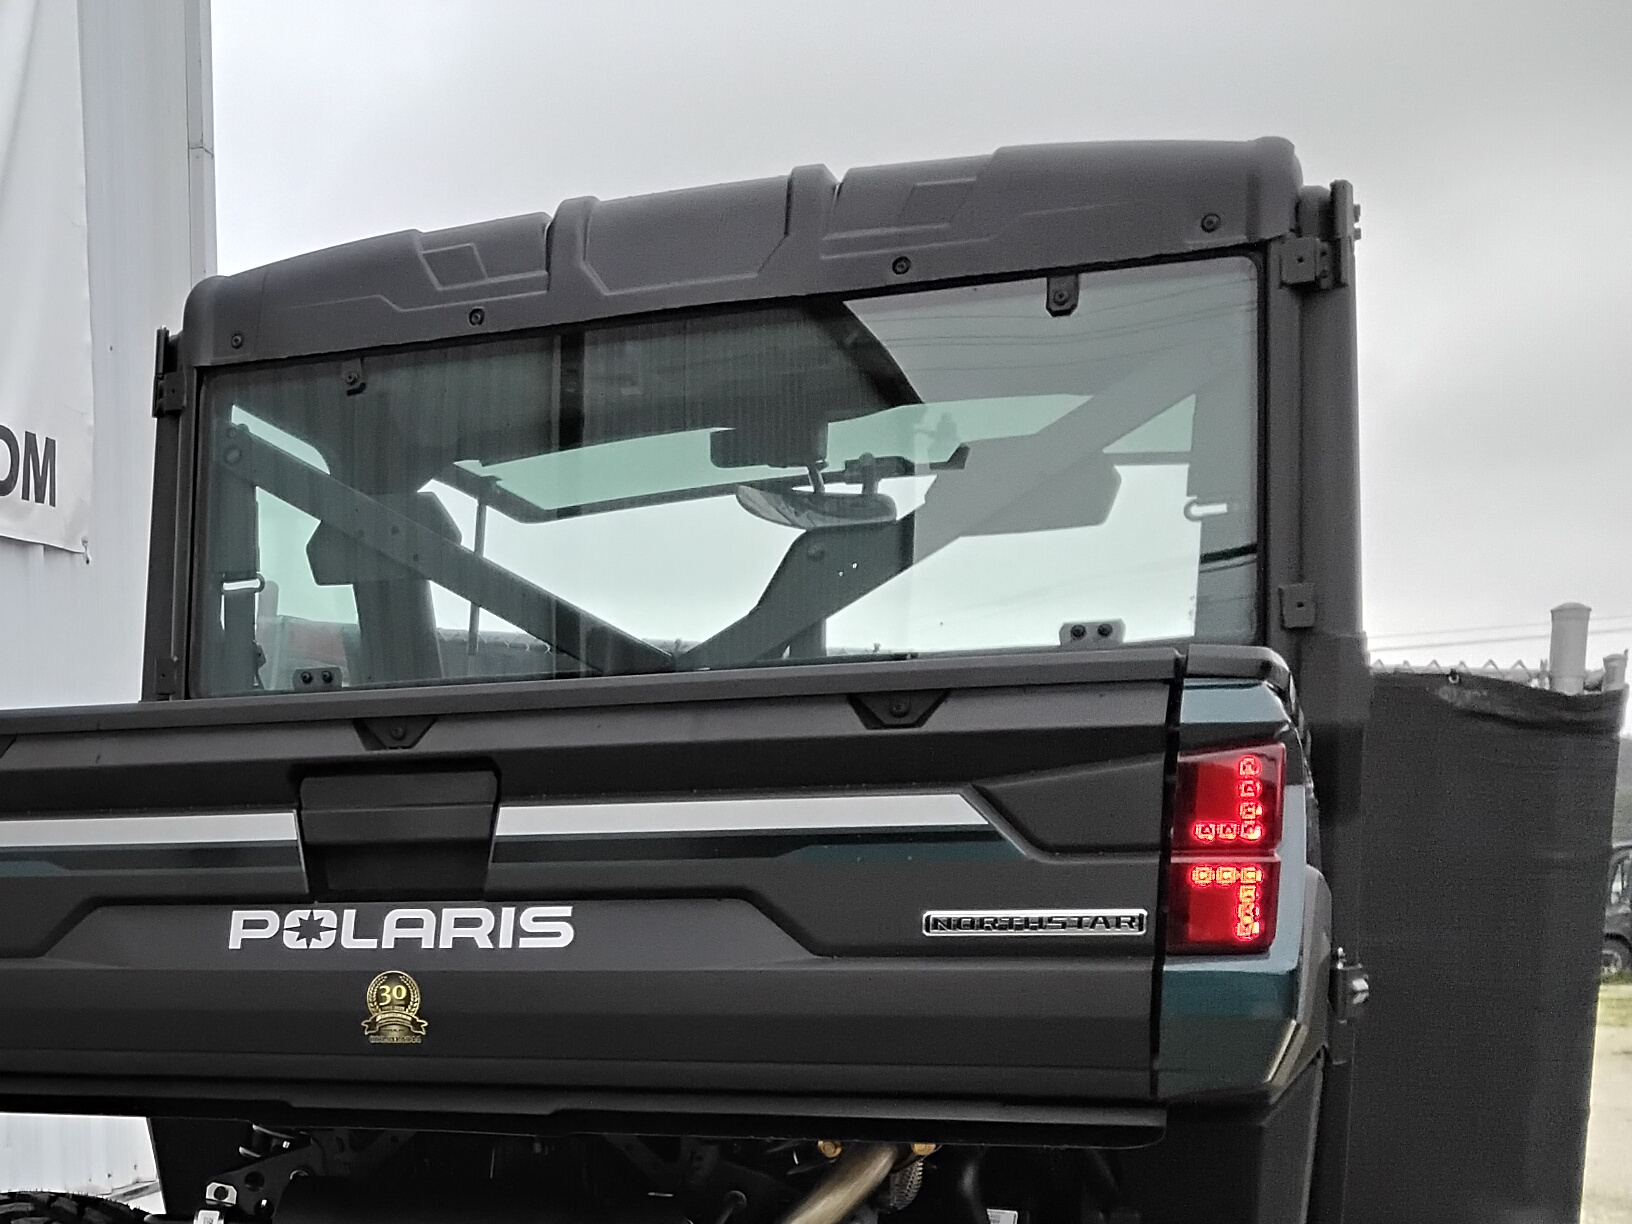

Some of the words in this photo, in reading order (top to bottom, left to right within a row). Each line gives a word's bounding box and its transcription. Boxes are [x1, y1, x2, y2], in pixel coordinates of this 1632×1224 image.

[228, 906, 575, 949] POLARIS
[928, 913, 1140, 933] NORTHSTAR
[379, 985, 407, 1006] 30
